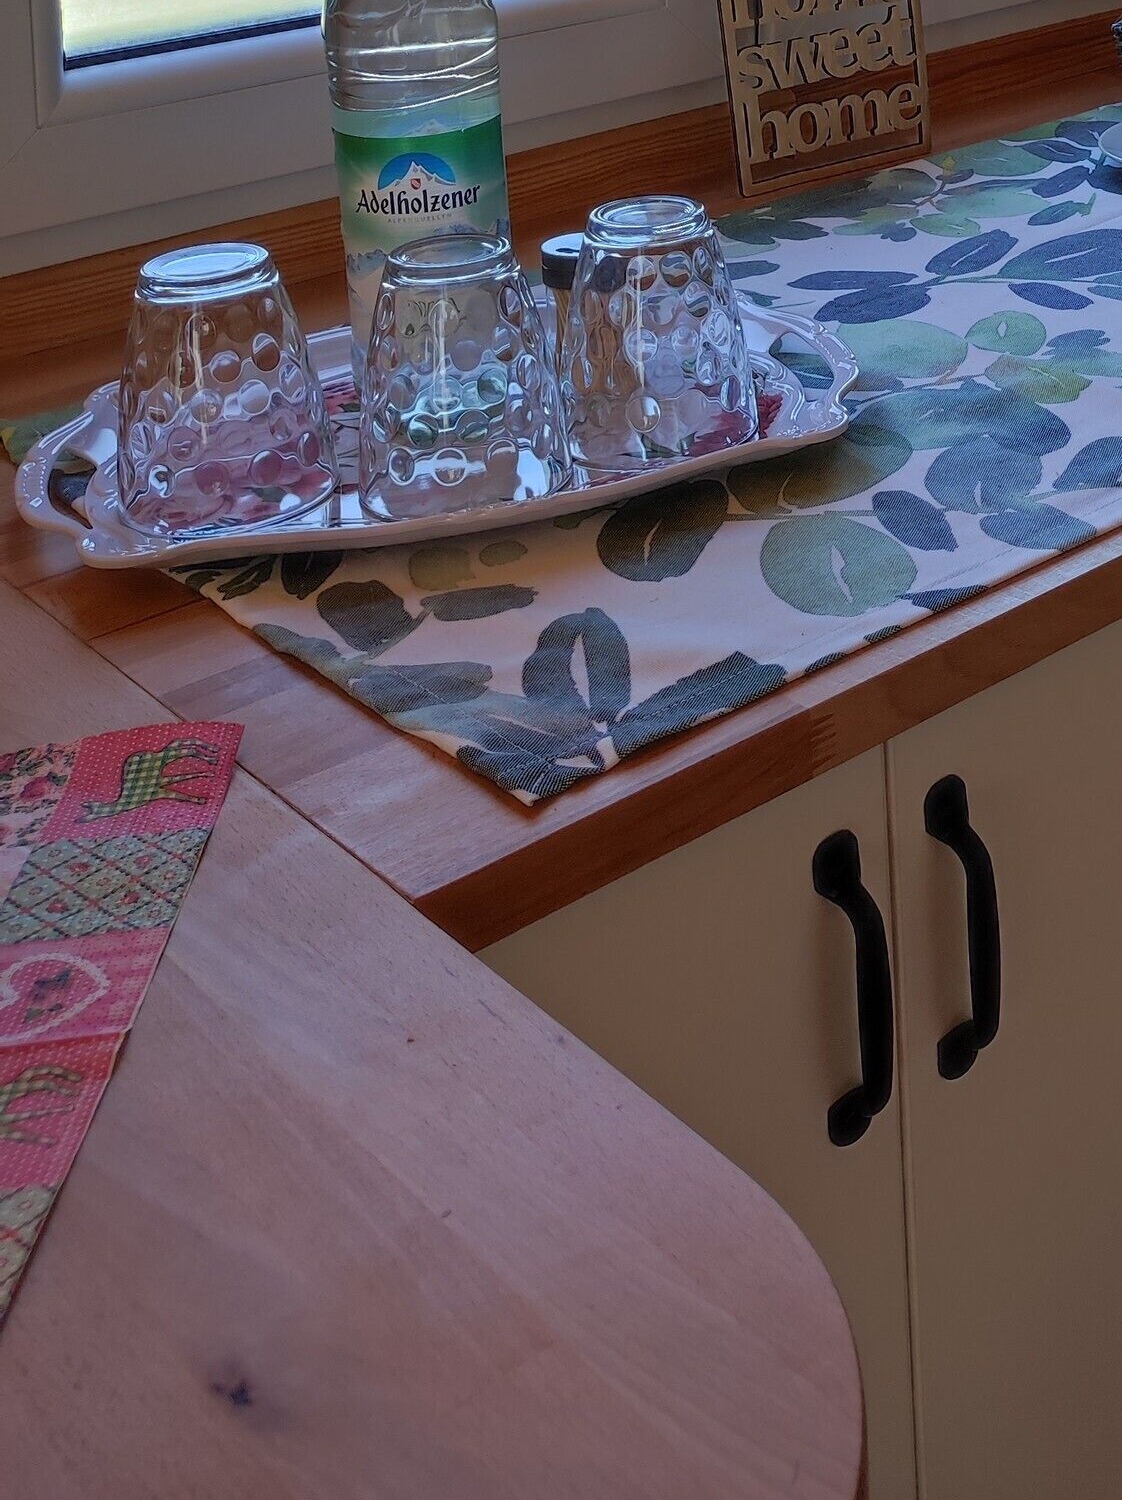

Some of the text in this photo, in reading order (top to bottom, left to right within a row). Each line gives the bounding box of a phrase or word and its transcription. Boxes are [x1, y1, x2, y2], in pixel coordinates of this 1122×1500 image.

[737, 5, 917, 94] sweet
[741, 82, 922, 164] home
[355, 184, 480, 215] Adelholzener
